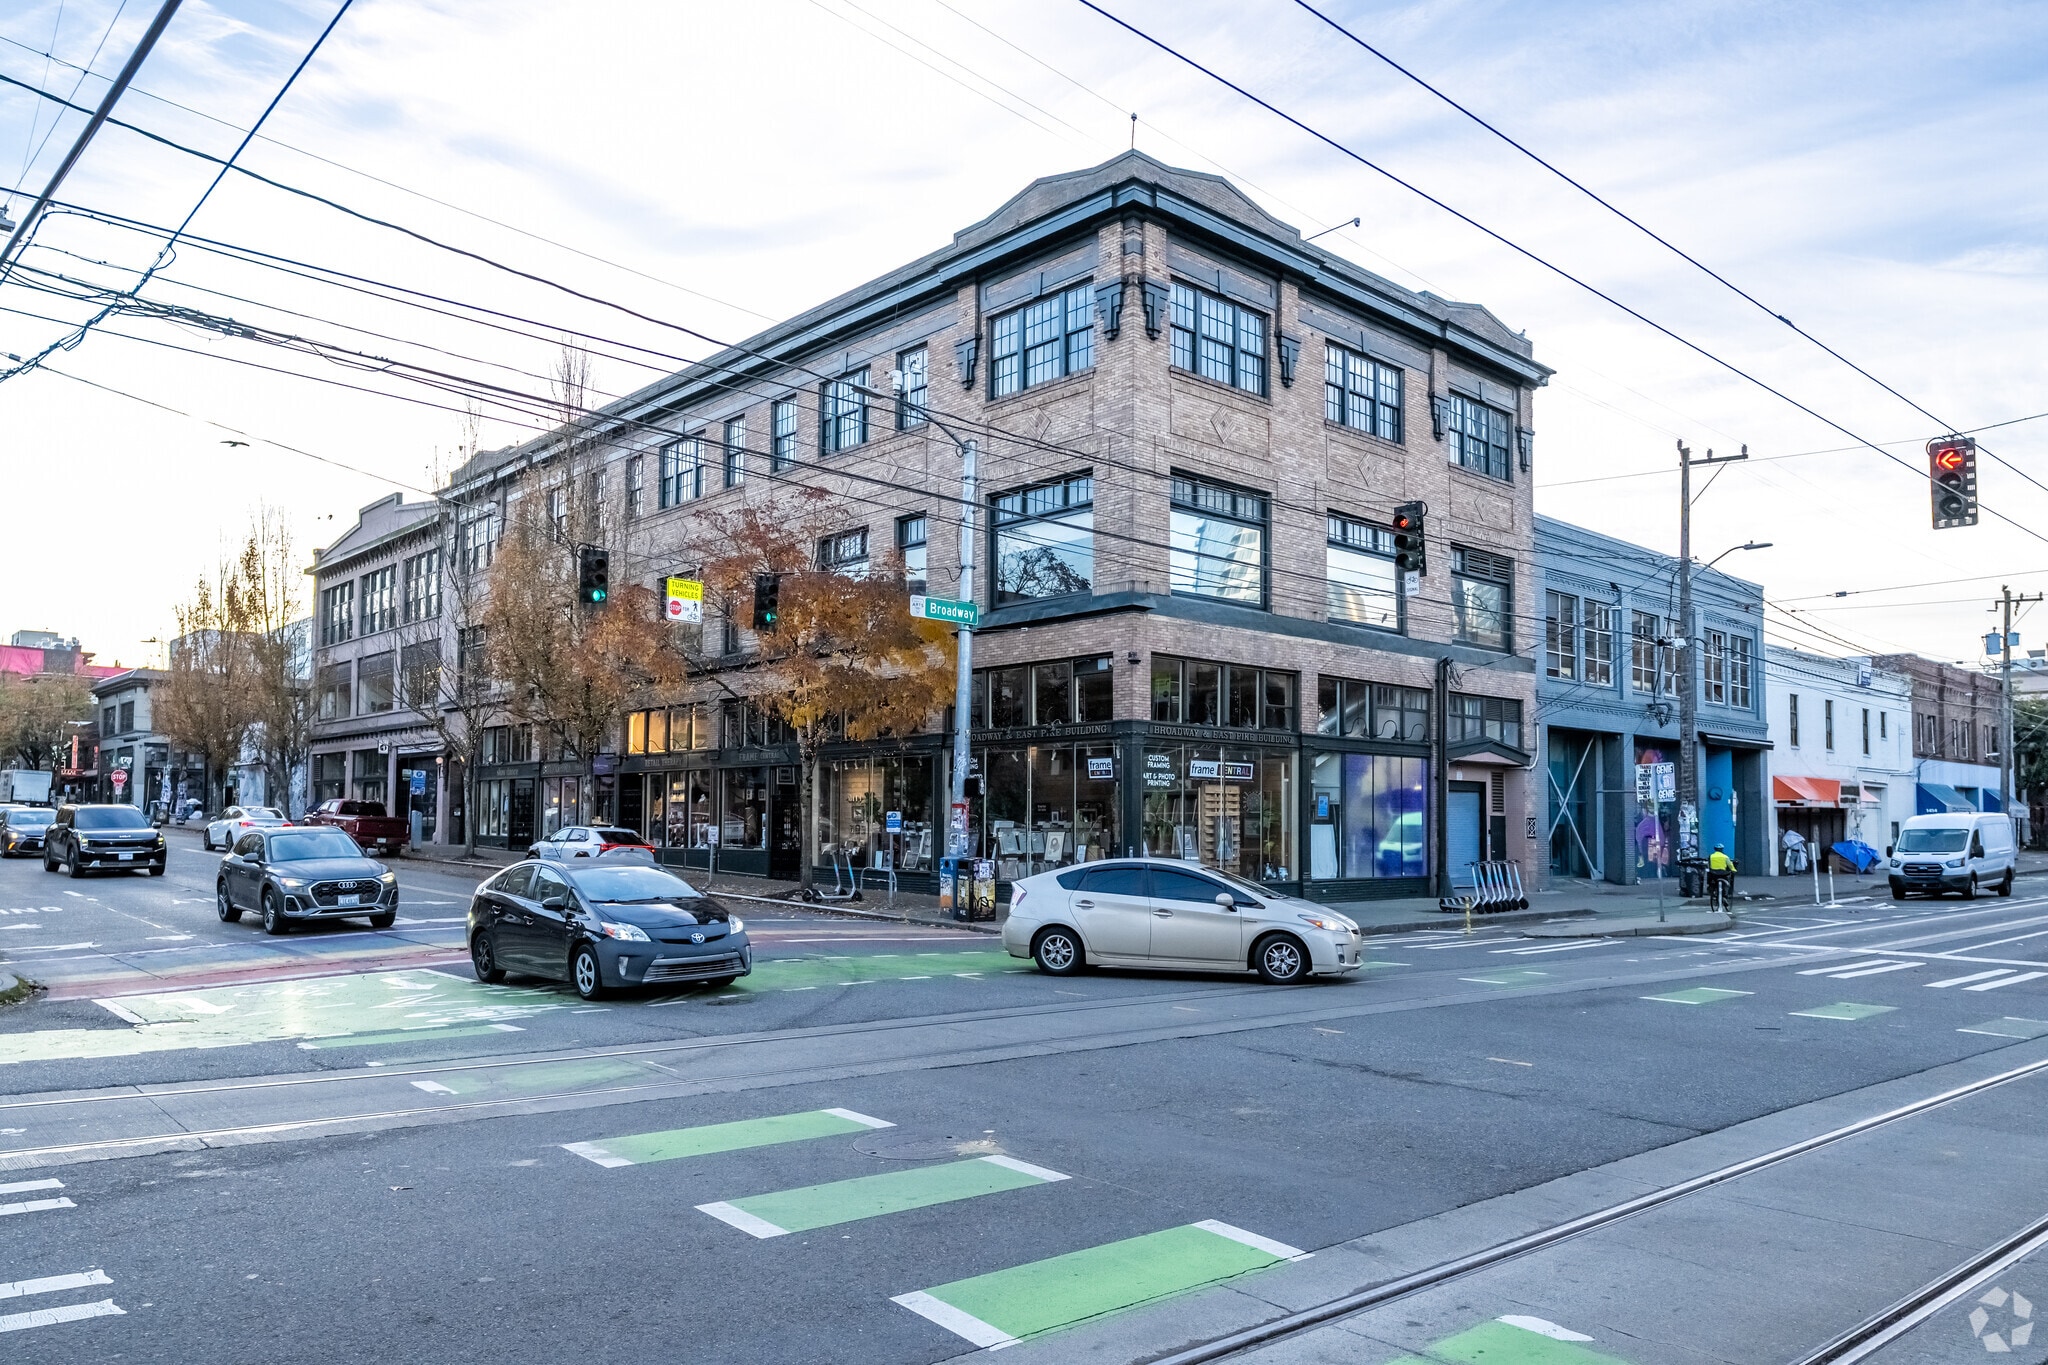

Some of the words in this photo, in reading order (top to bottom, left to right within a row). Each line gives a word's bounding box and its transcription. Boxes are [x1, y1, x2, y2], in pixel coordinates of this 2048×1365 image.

[672, 581, 699, 591] TURNING
[671, 589, 698, 599] VEHICLES
[930, 602, 974, 622] Broadway
[971, 732, 1003, 742] OADWAY
[1016, 730, 1037, 739] EAST
[1065, 725, 1107, 735] BUILDING
[1154, 725, 1199, 737] BROADWAY
[1202, 730, 1210, 738] &
[1212, 731, 1234, 740] EAST
[1236, 733, 1255, 741] PIKE
[1258, 734, 1293, 744] BUILDING
[739, 752, 758, 761] FRAME
[1148, 754, 1170, 762] CUSTOM
[644, 758, 660, 767] RETAIL
[1090, 760, 1112, 769] frame
[1147, 761, 1170, 769] FRAMING
[1191, 763, 1215, 774] frame
[1656, 764, 1674, 775] GENIE
[1147, 779, 1170, 787] PRINTING
[1658, 789, 1676, 799] GENIE
